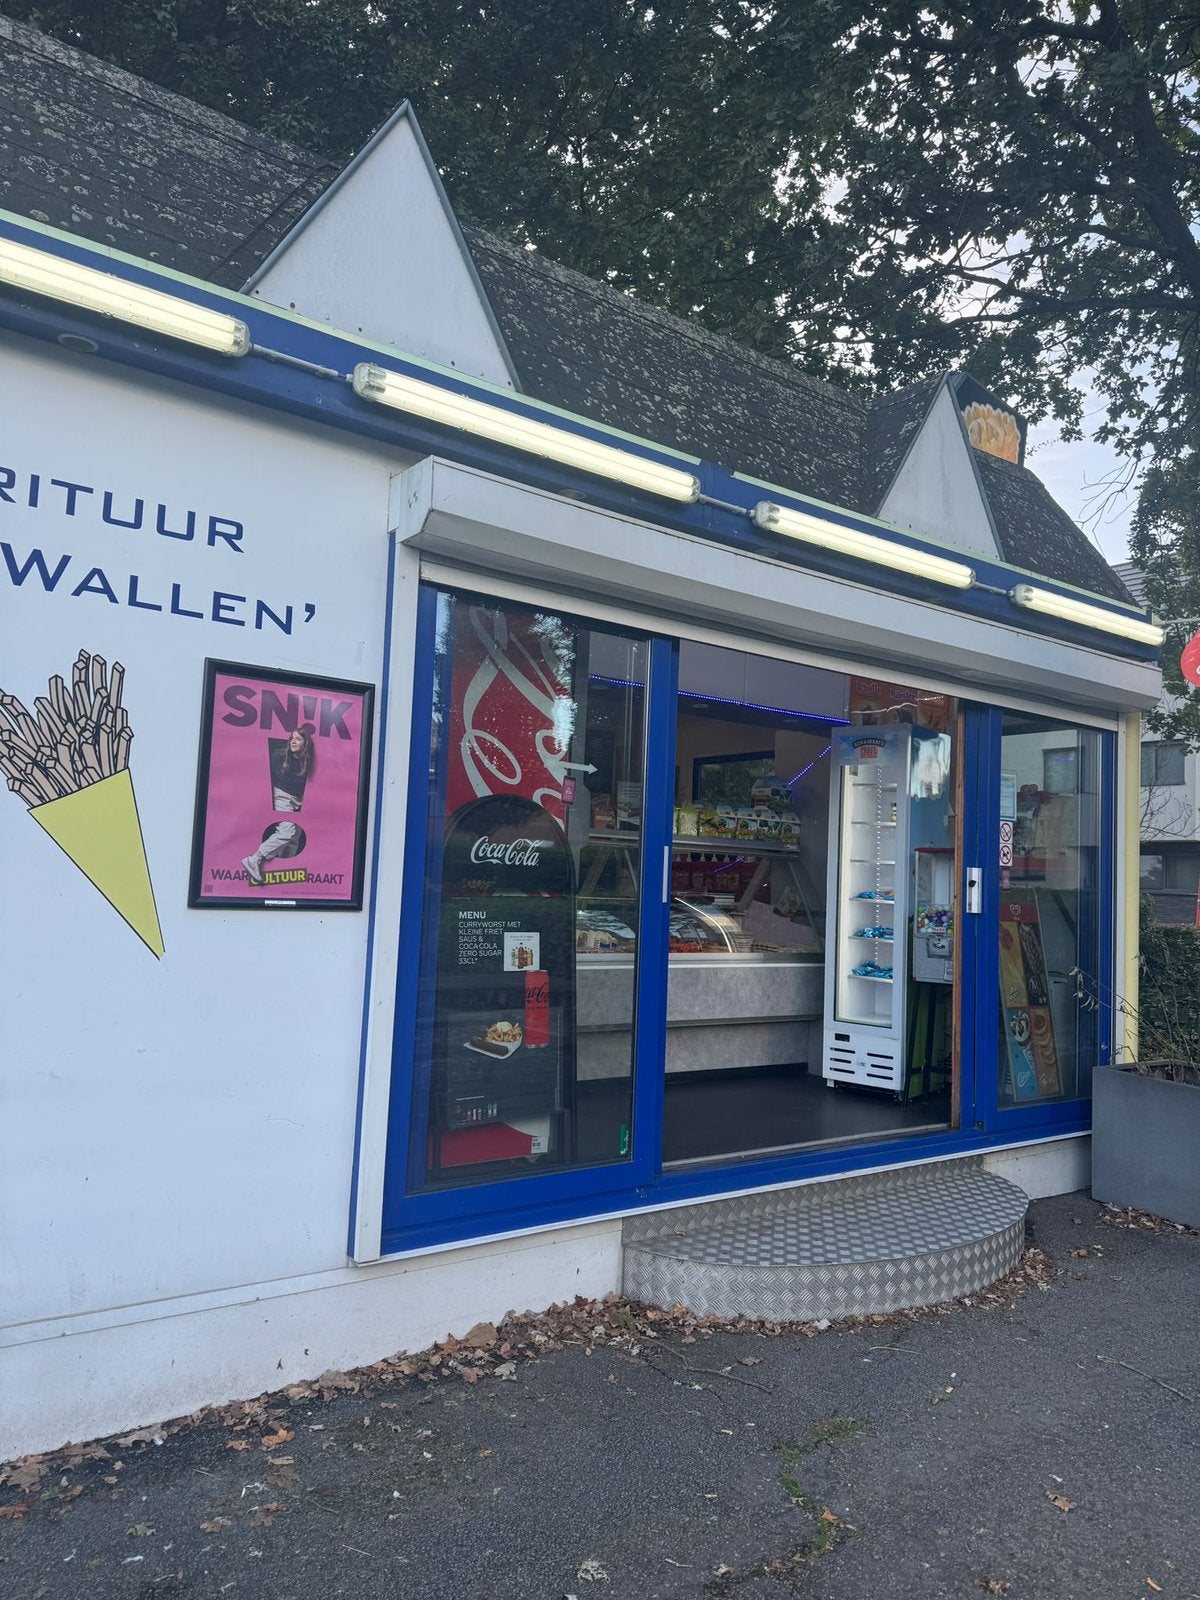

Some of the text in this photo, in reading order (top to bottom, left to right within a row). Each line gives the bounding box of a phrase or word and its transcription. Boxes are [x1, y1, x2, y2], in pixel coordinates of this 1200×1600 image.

[211, 869, 344, 885] WAAR ULTUUR RAAKT
[458, 911, 487, 919] MENU
[458, 928, 483, 936] KLEINE
[478, 949, 503, 957] SUGAR
